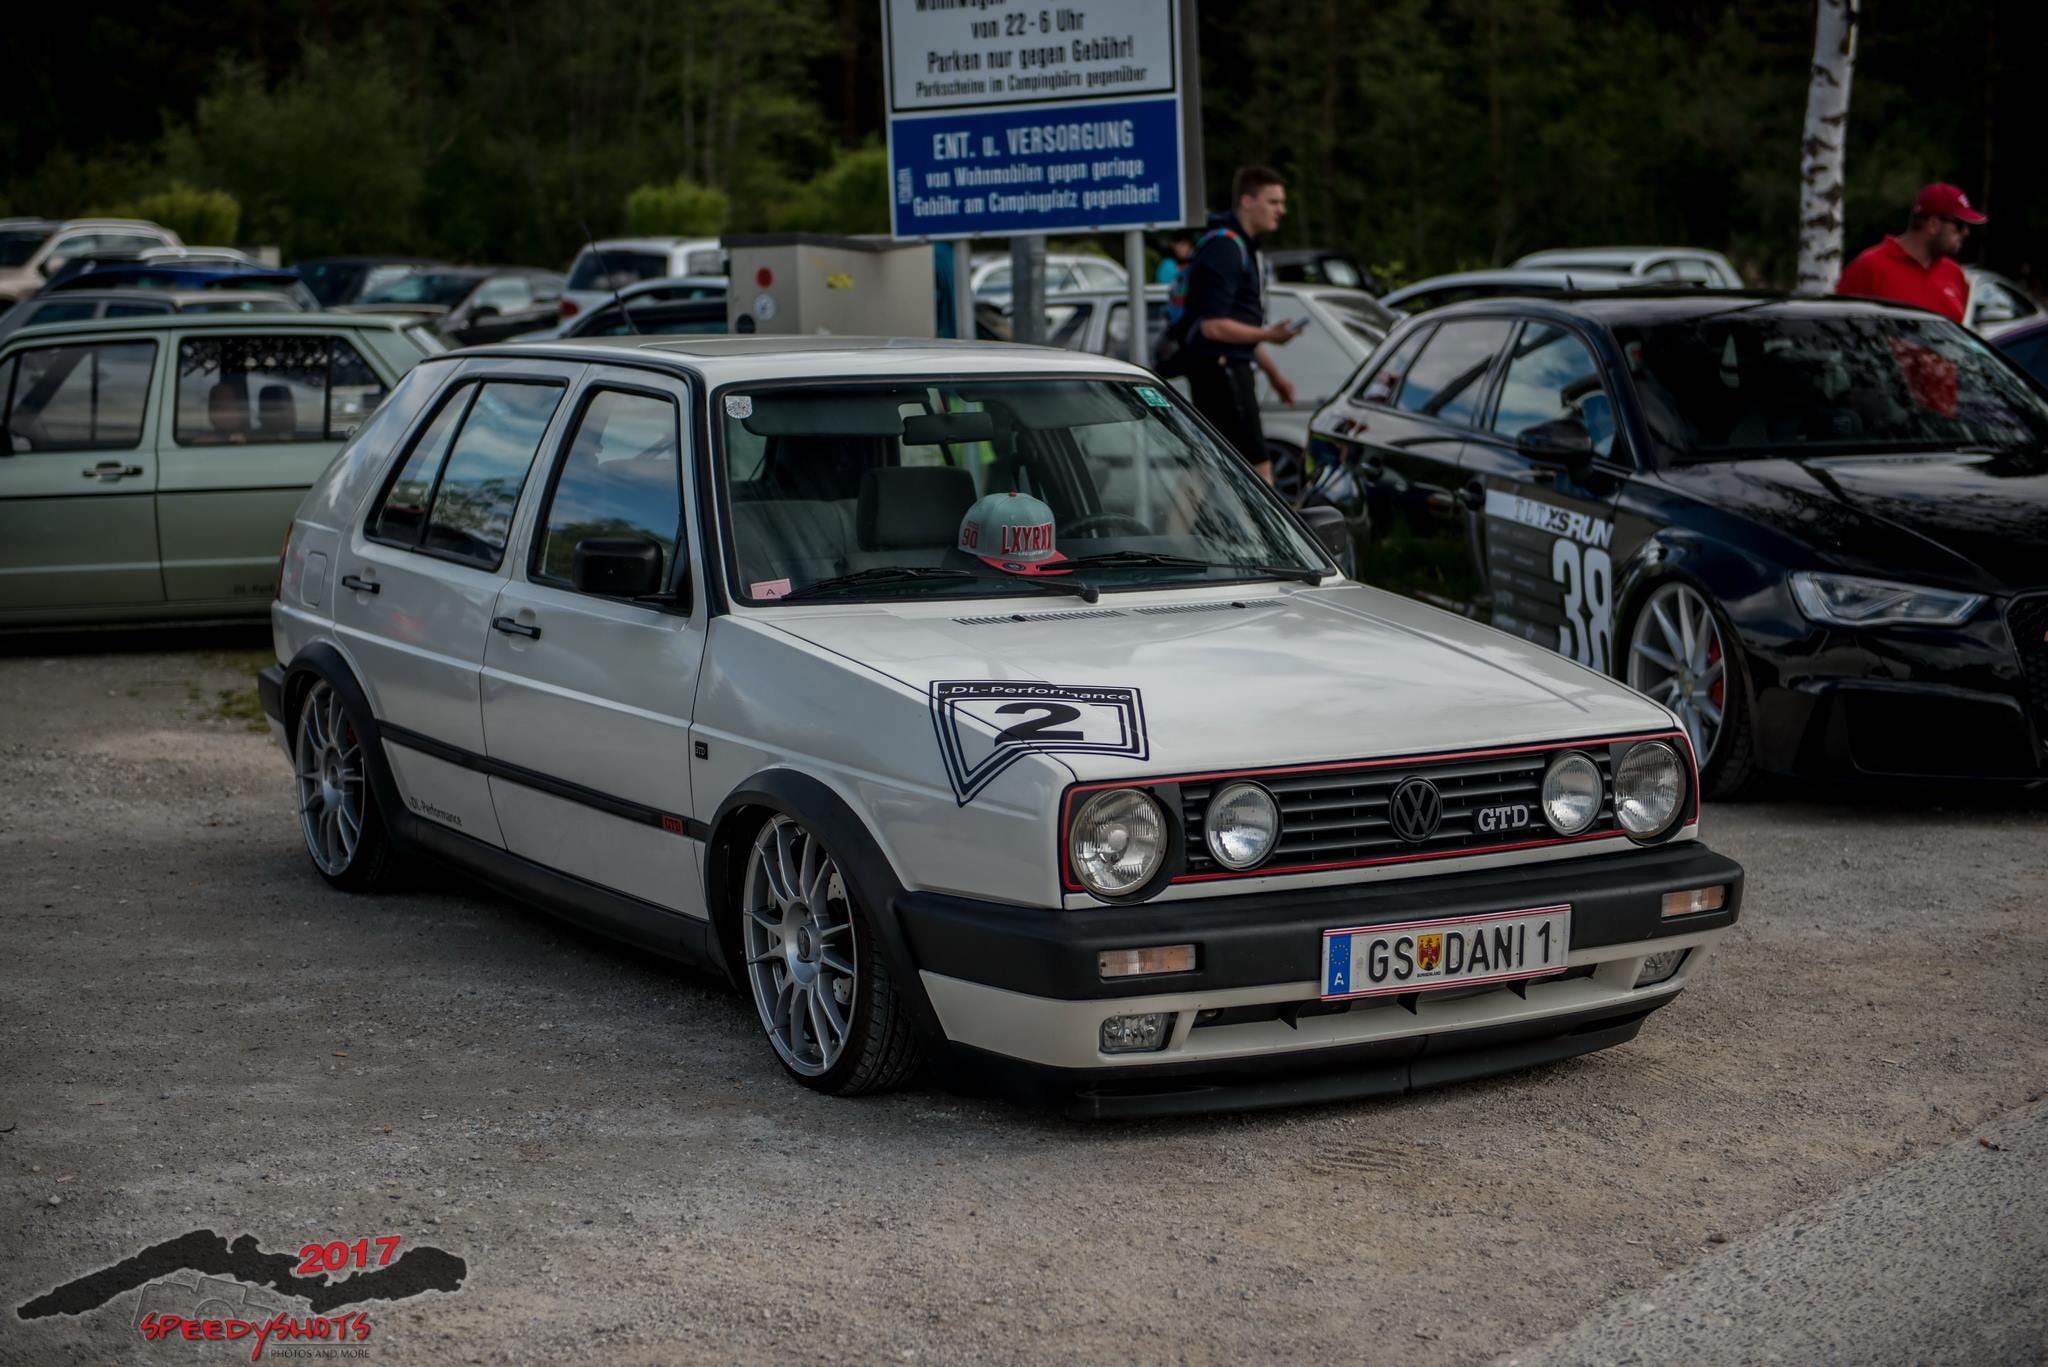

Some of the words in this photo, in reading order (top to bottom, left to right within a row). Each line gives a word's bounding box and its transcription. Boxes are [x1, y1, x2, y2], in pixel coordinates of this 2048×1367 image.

[971, 20, 999, 39] von
[1057, 9, 1085, 31] Uhr
[927, 51, 981, 74] Parken
[987, 50, 1012, 70] nur
[1019, 45, 1066, 70] gegen
[1072, 35, 1134, 62] Gebühr!
[916, 78, 985, 97] Parkscheine
[990, 75, 1003, 92] im
[1007, 69, 1082, 93] Campingbüro
[1087, 65, 1147, 87] gegenüber
[933, 131, 976, 160] ENT.
[982, 136, 1000, 157] u.
[1007, 119, 1134, 156] VERSORGUNG
[925, 171, 950, 189] von
[955, 163, 1043, 187] Wohnmobilen
[1047, 162, 1088, 184] gegen
[1093, 157, 1144, 180] geringe
[913, 194, 959, 216] Gebühr
[964, 195, 985, 213] am
[988, 189, 1078, 214] Campingplatz
[1082, 183, 1160, 209] gegenüber!
[1552, 537, 1614, 677] 38
[951, 685, 1132, 701] DL-Performance
[994, 702, 1084, 747] 2
[1478, 804, 1529, 832] GTD
[1333, 972, 1345, 987] A
[1368, 936, 1414, 983] GS
[1445, 922, 1526, 975] DANI
[1538, 920, 1551, 964] 1
